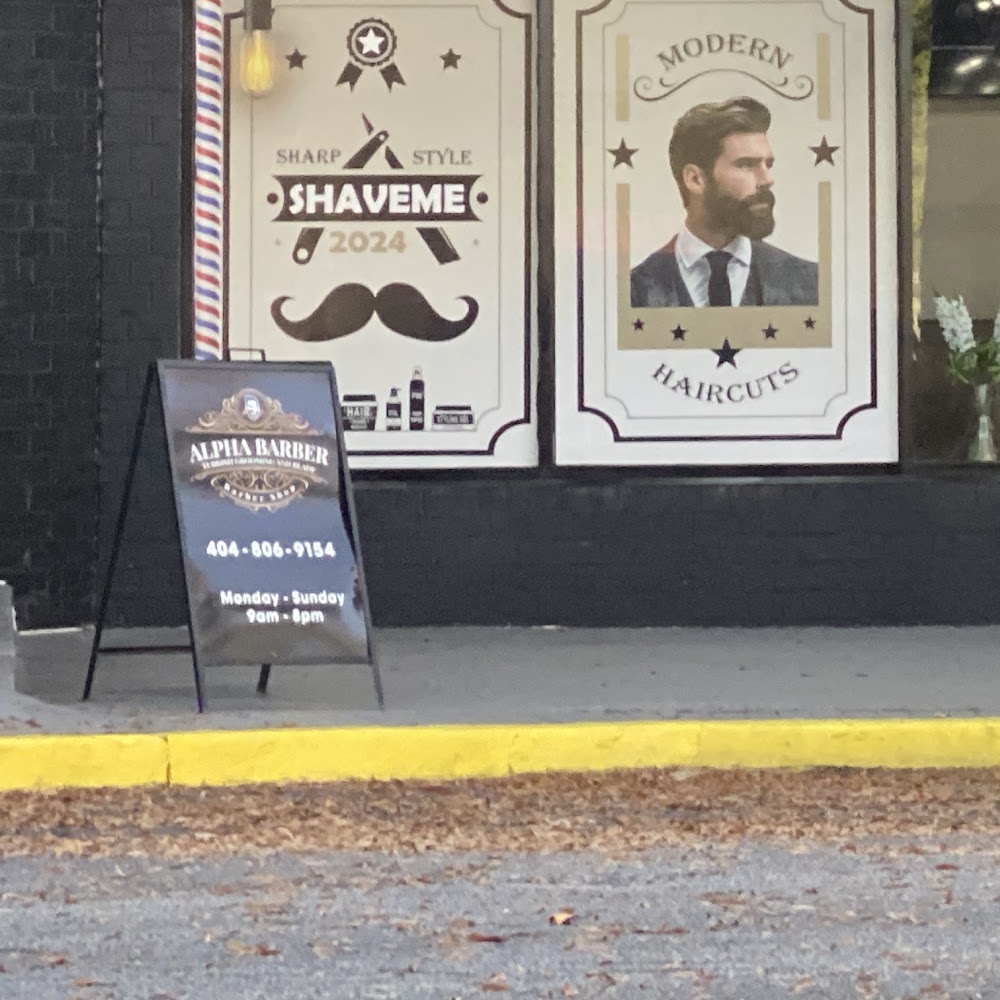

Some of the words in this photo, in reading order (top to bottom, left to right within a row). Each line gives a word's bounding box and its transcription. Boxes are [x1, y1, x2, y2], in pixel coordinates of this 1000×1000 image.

[656, 33, 793, 72] MODERN
[275, 148, 342, 165] SHARP
[412, 147, 473, 166] STYLE
[289, 182, 466, 216] SHAVEME
[328, 230, 407, 254] 2024
[651, 361, 801, 404] HAIRCUTS
[189, 437, 252, 465] ALPHA
[255, 437, 329, 466] BARBER
[220, 590, 279, 607] Monday
[291, 589, 345, 607] Sunday
[246, 608, 280, 624] 9am
[291, 607, 324, 625] 8pm
